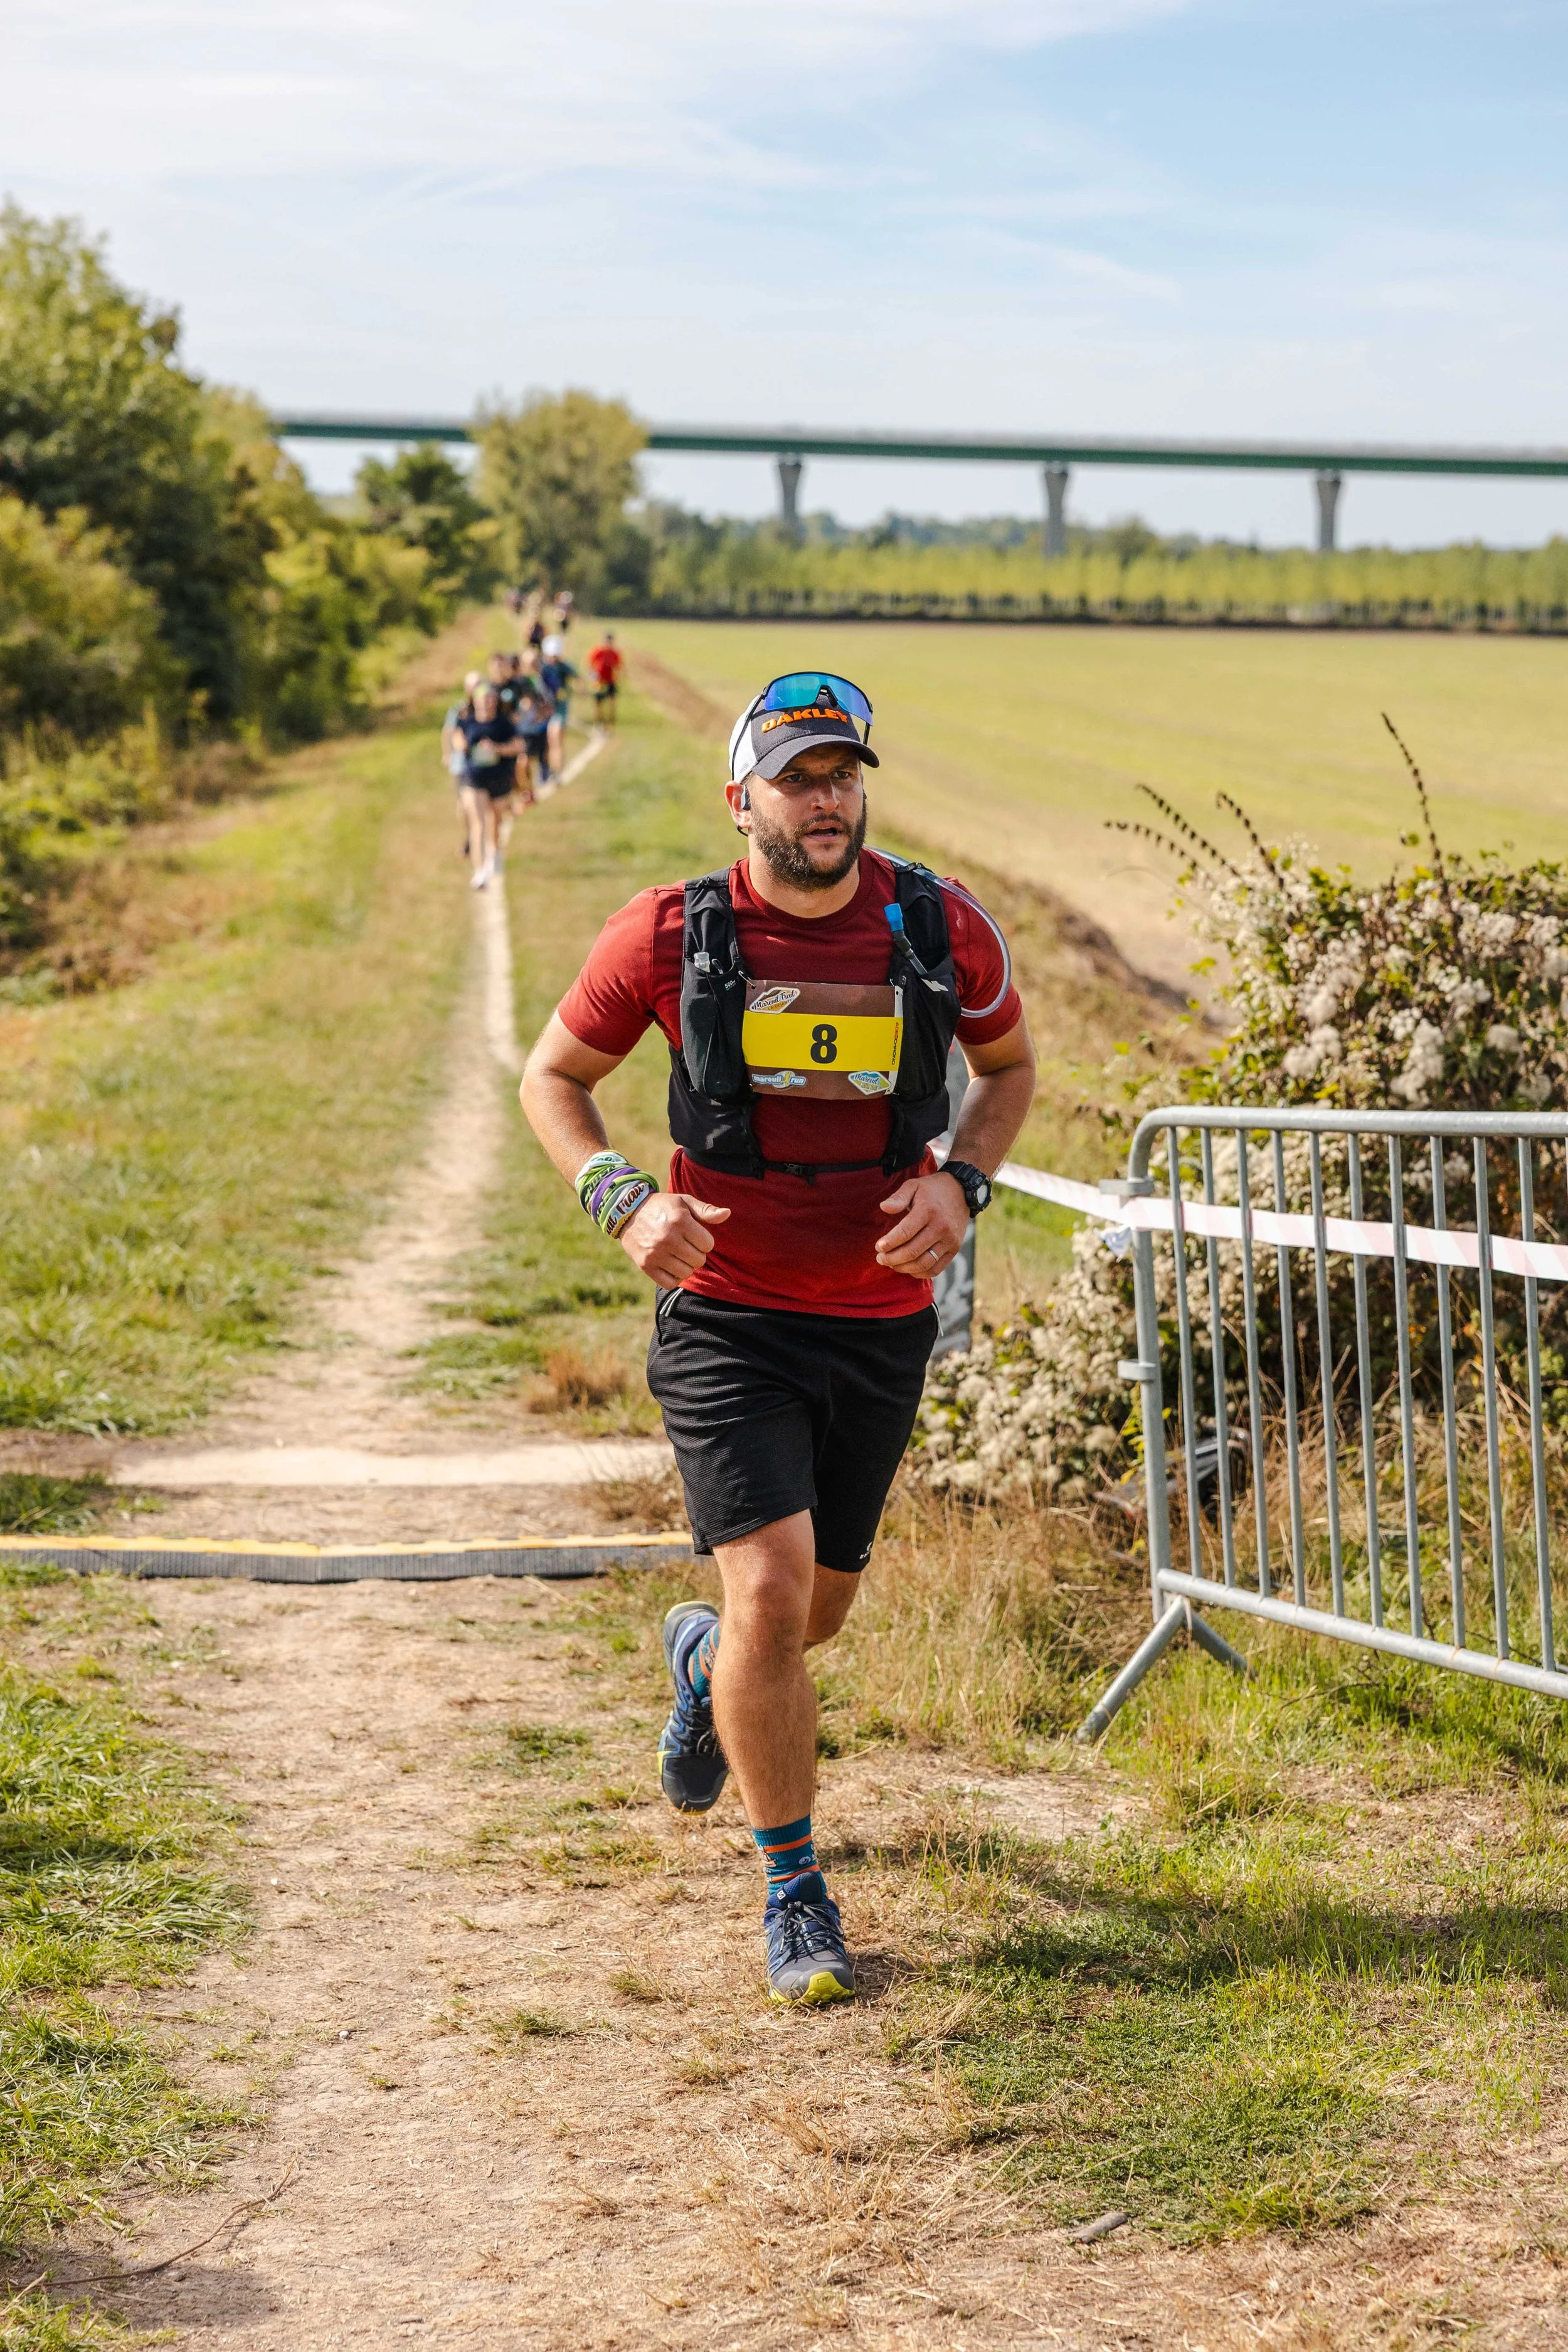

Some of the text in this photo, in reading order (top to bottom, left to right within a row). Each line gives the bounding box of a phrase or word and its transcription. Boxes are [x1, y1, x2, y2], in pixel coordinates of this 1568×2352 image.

[761, 708, 847, 733] OAKLEY
[780, 990, 795, 1001] Trail
[810, 1024, 837, 1064] 8
